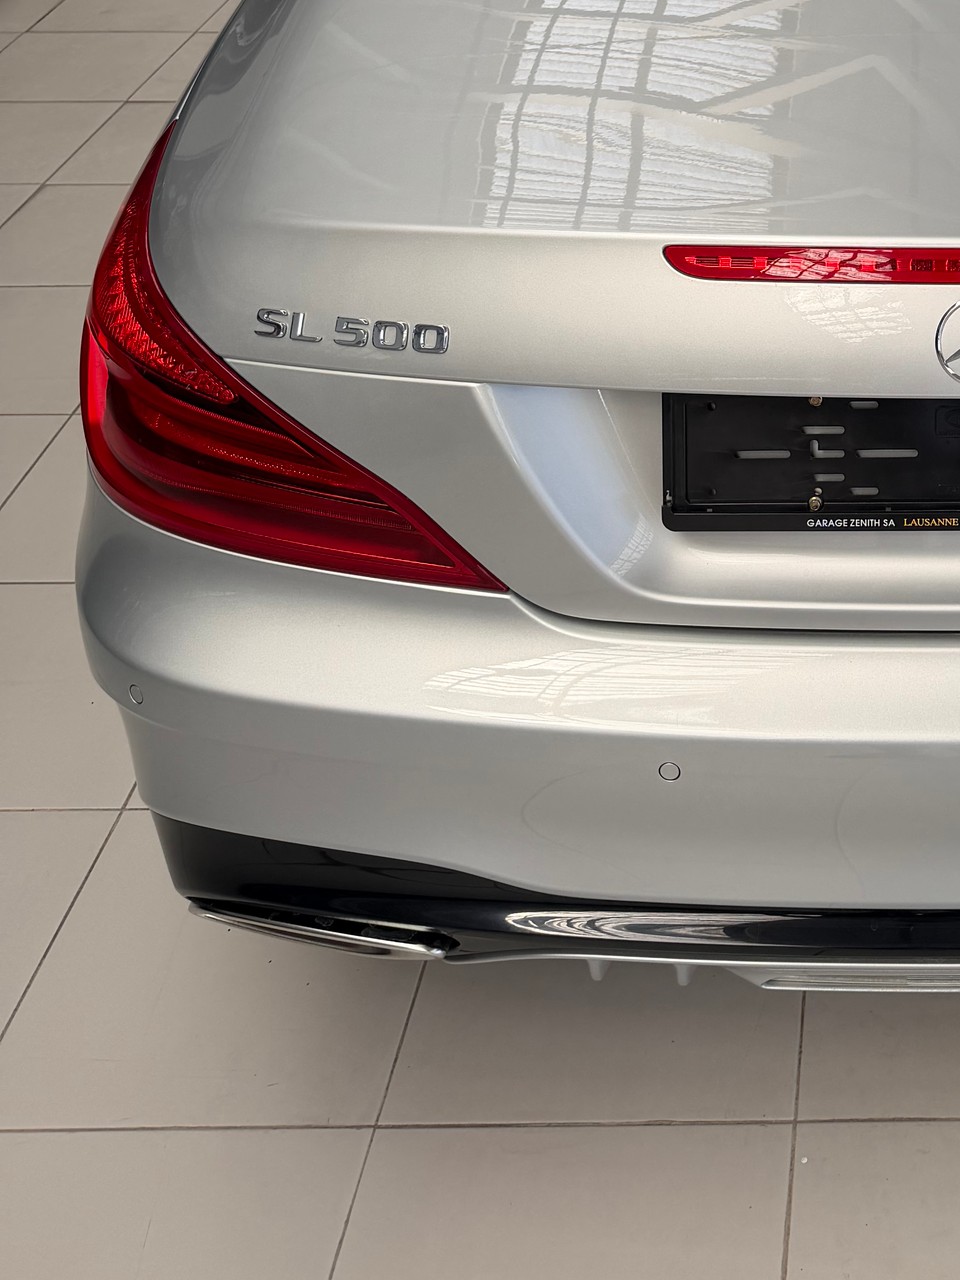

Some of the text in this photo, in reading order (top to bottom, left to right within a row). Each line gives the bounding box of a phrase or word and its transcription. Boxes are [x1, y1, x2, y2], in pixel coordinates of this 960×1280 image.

[254, 308, 450, 354] SL 500
[806, 518, 848, 528] GARAGE
[850, 518, 881, 527] ZENITH
[883, 518, 896, 527] SA
[903, 518, 959, 527] LAUSANNE
